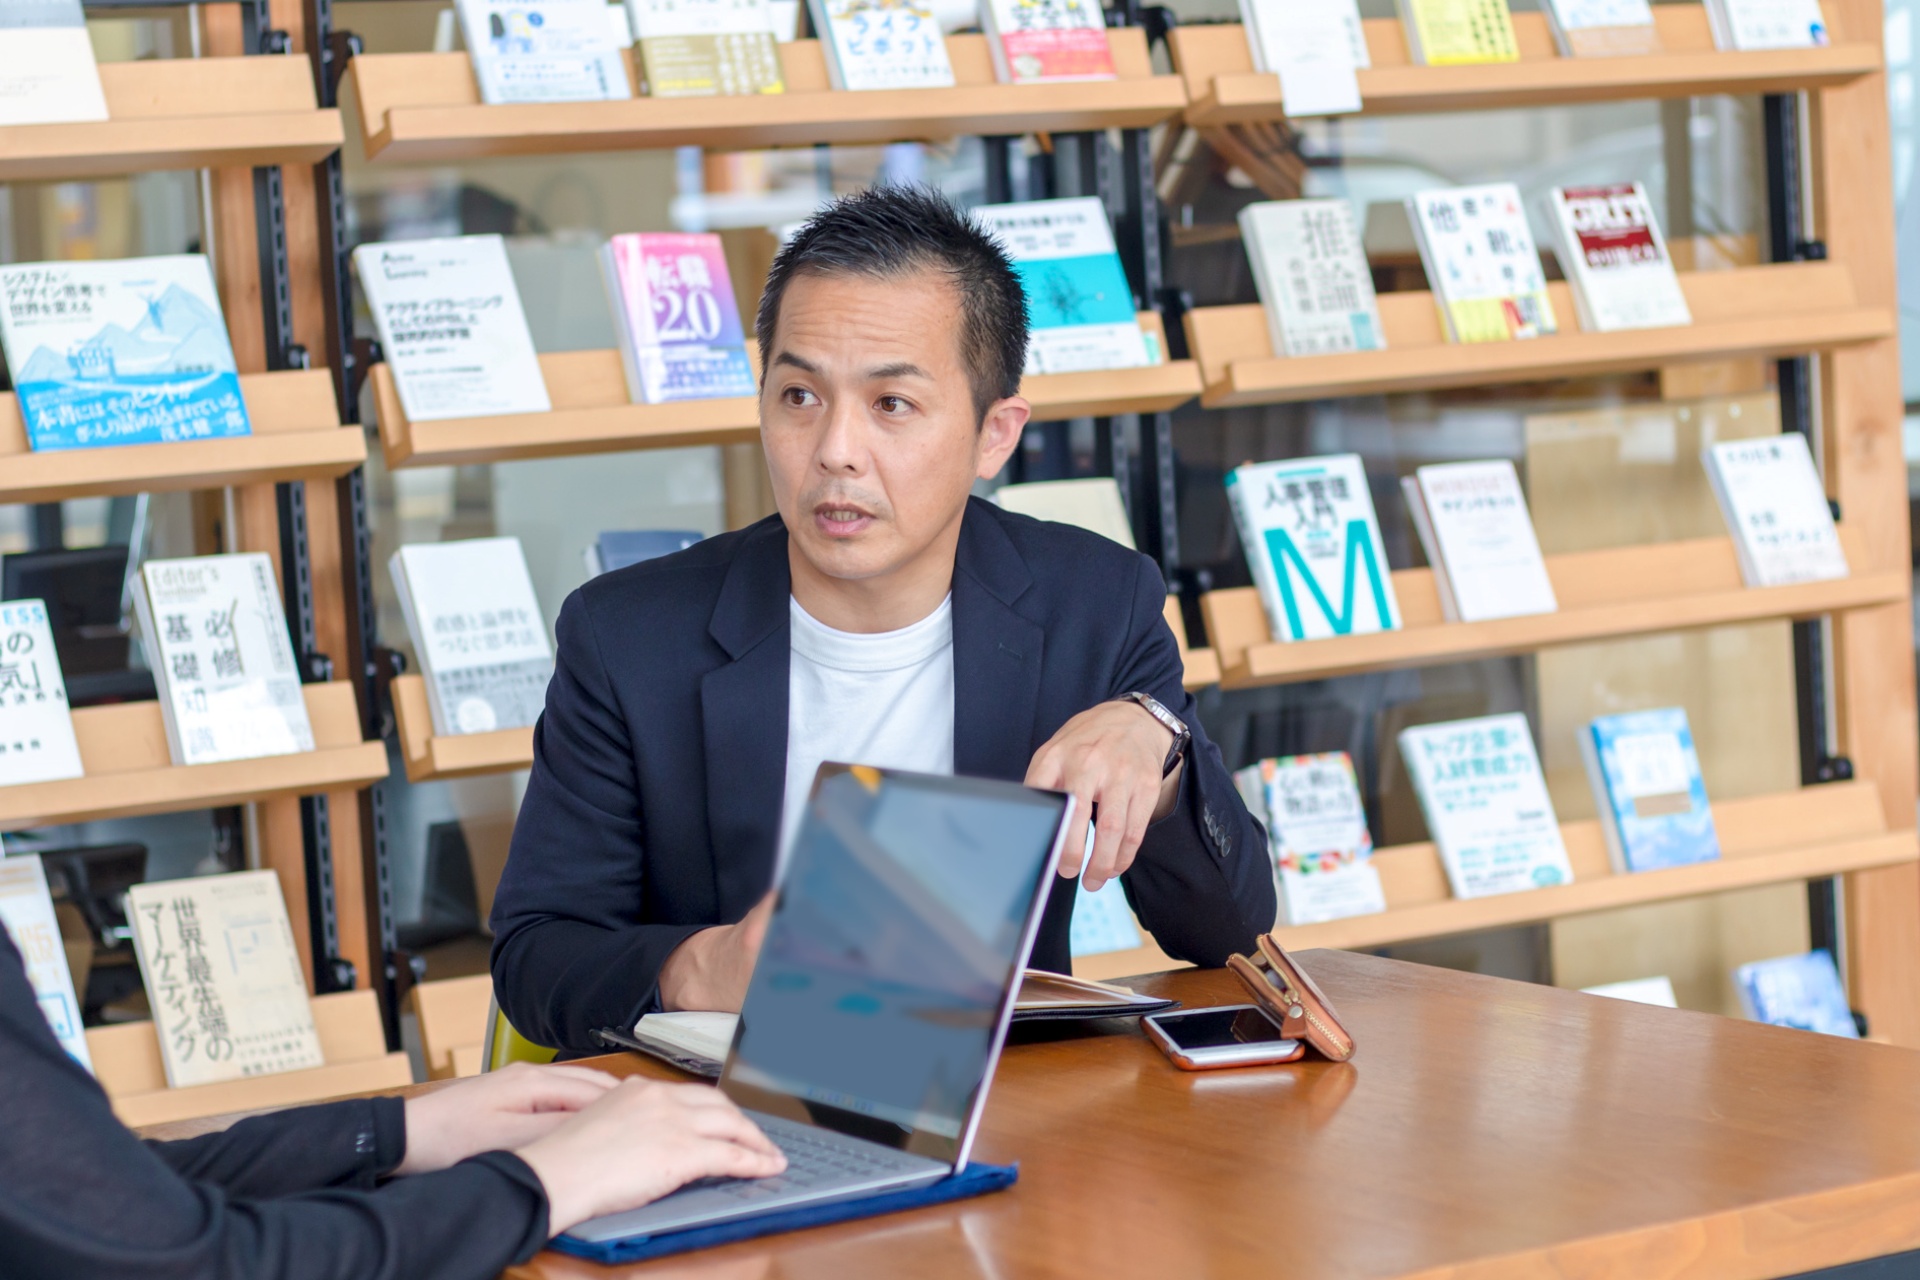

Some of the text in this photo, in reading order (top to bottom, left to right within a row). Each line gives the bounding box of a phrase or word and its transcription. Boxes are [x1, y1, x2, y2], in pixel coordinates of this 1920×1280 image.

[1566, 195, 1648, 231] GRIT
[10, 299, 92, 317] 世界を変える
[653, 288, 721, 341] 2.0
[1264, 477, 1350, 509] 人事管理
[1295, 502, 1338, 531] 入門
[152, 564, 219, 585] Editor's
[1263, 519, 1393, 641] M
[433, 607, 529, 634] 直感と論理を
[439, 628, 538, 654] つなぐ思考法
[164, 613, 217, 755] 基礎知識
[139, 901, 196, 1063] マーケティング
[170, 896, 234, 1061] 世界最先端の
